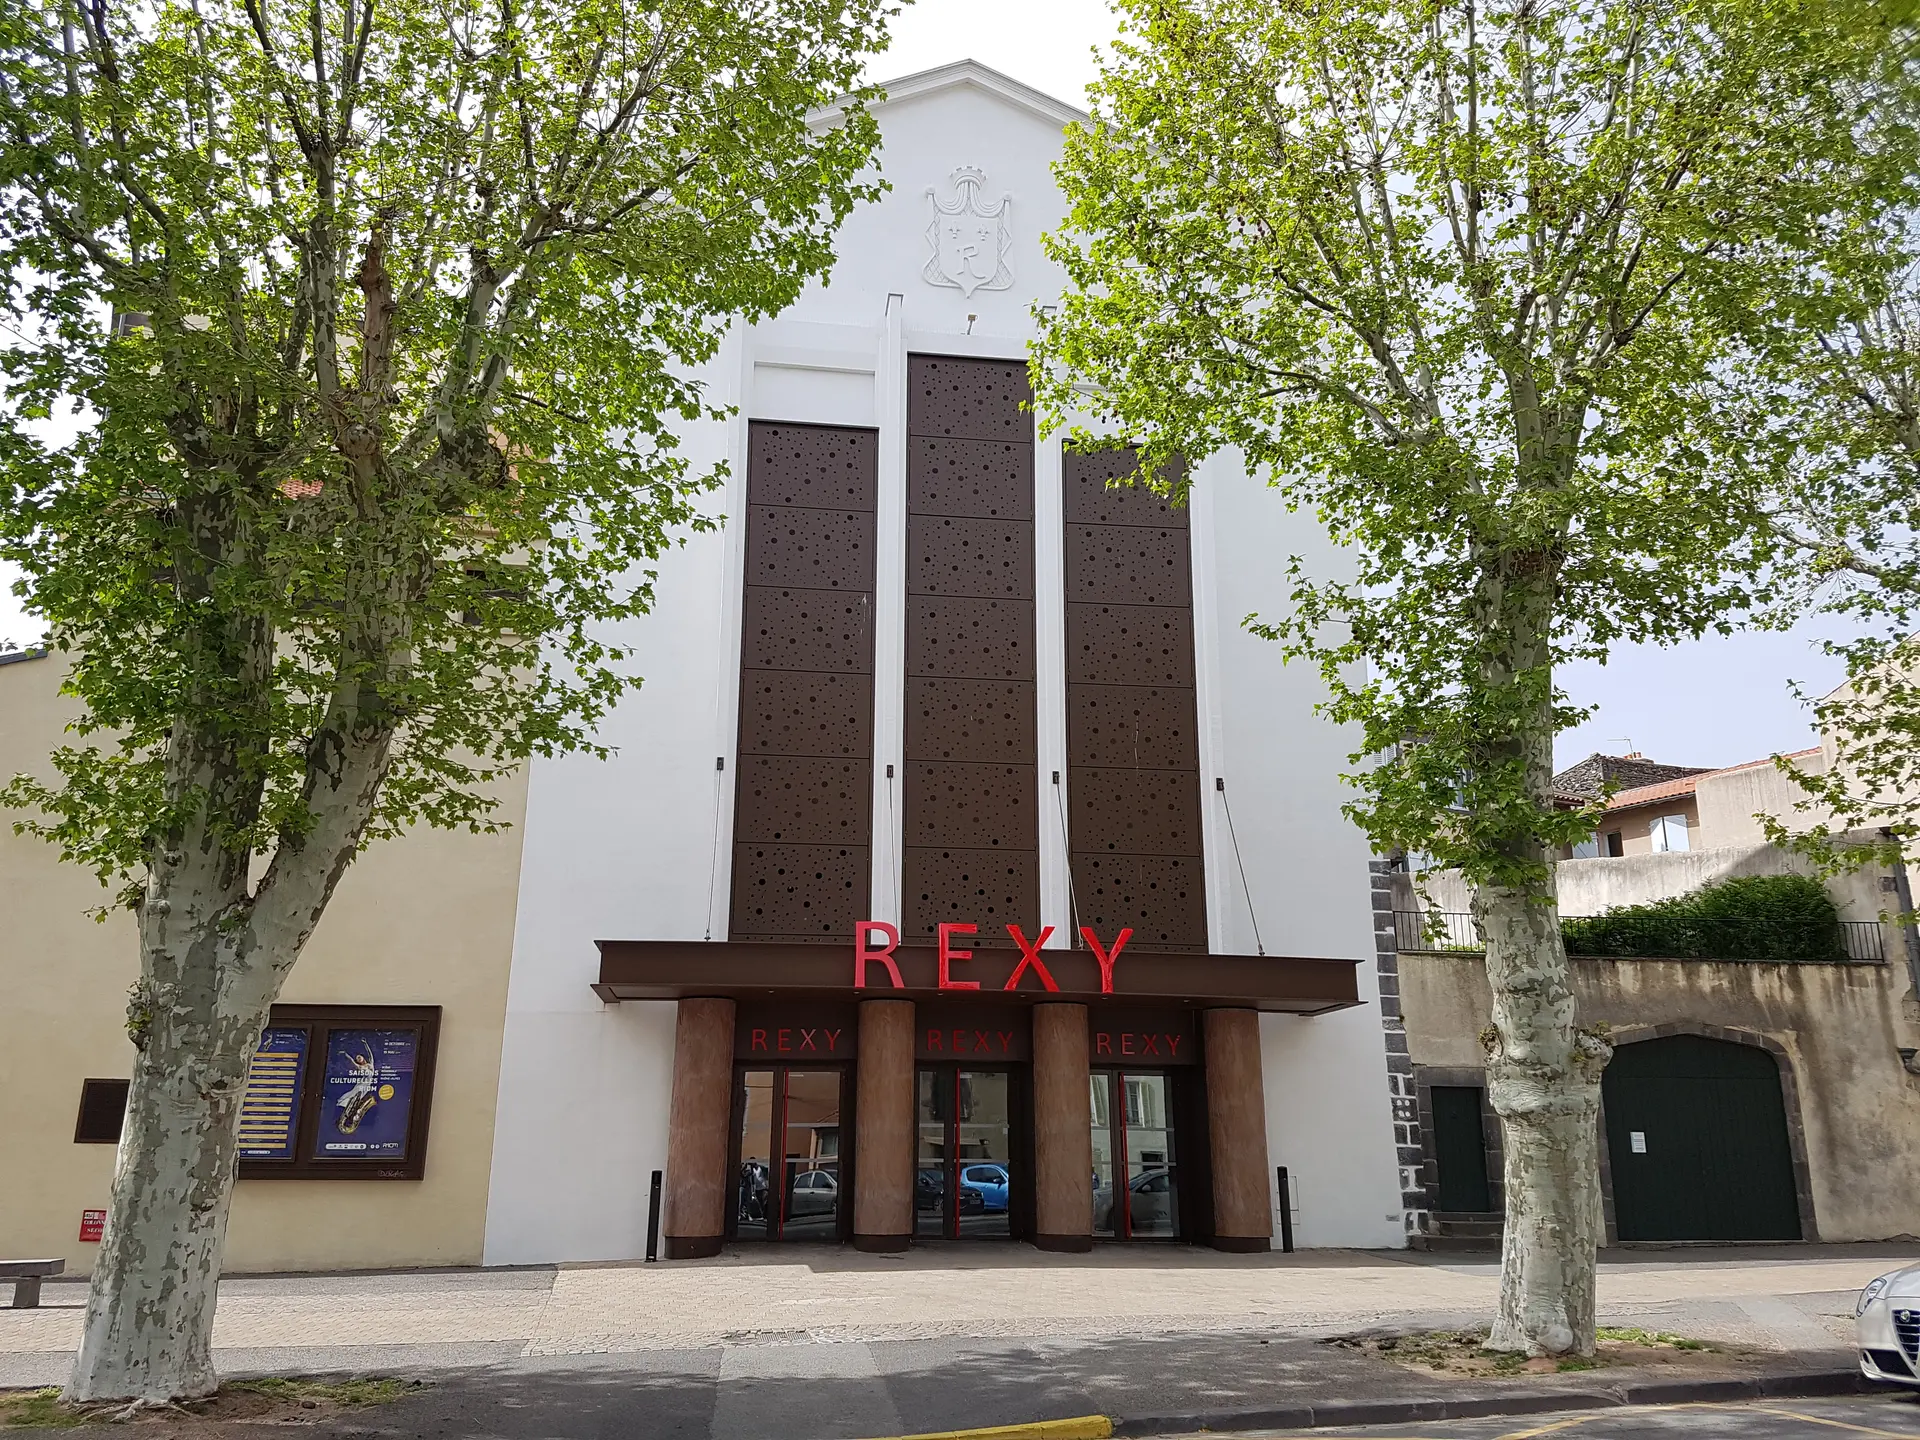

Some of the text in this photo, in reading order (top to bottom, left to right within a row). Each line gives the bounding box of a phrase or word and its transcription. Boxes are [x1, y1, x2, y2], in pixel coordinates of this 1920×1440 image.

[854, 920, 1134, 994] REXY
[752, 1028, 841, 1051] REXY
[927, 1029, 1014, 1053] REXY
[1095, 1033, 1181, 1056] REXY
